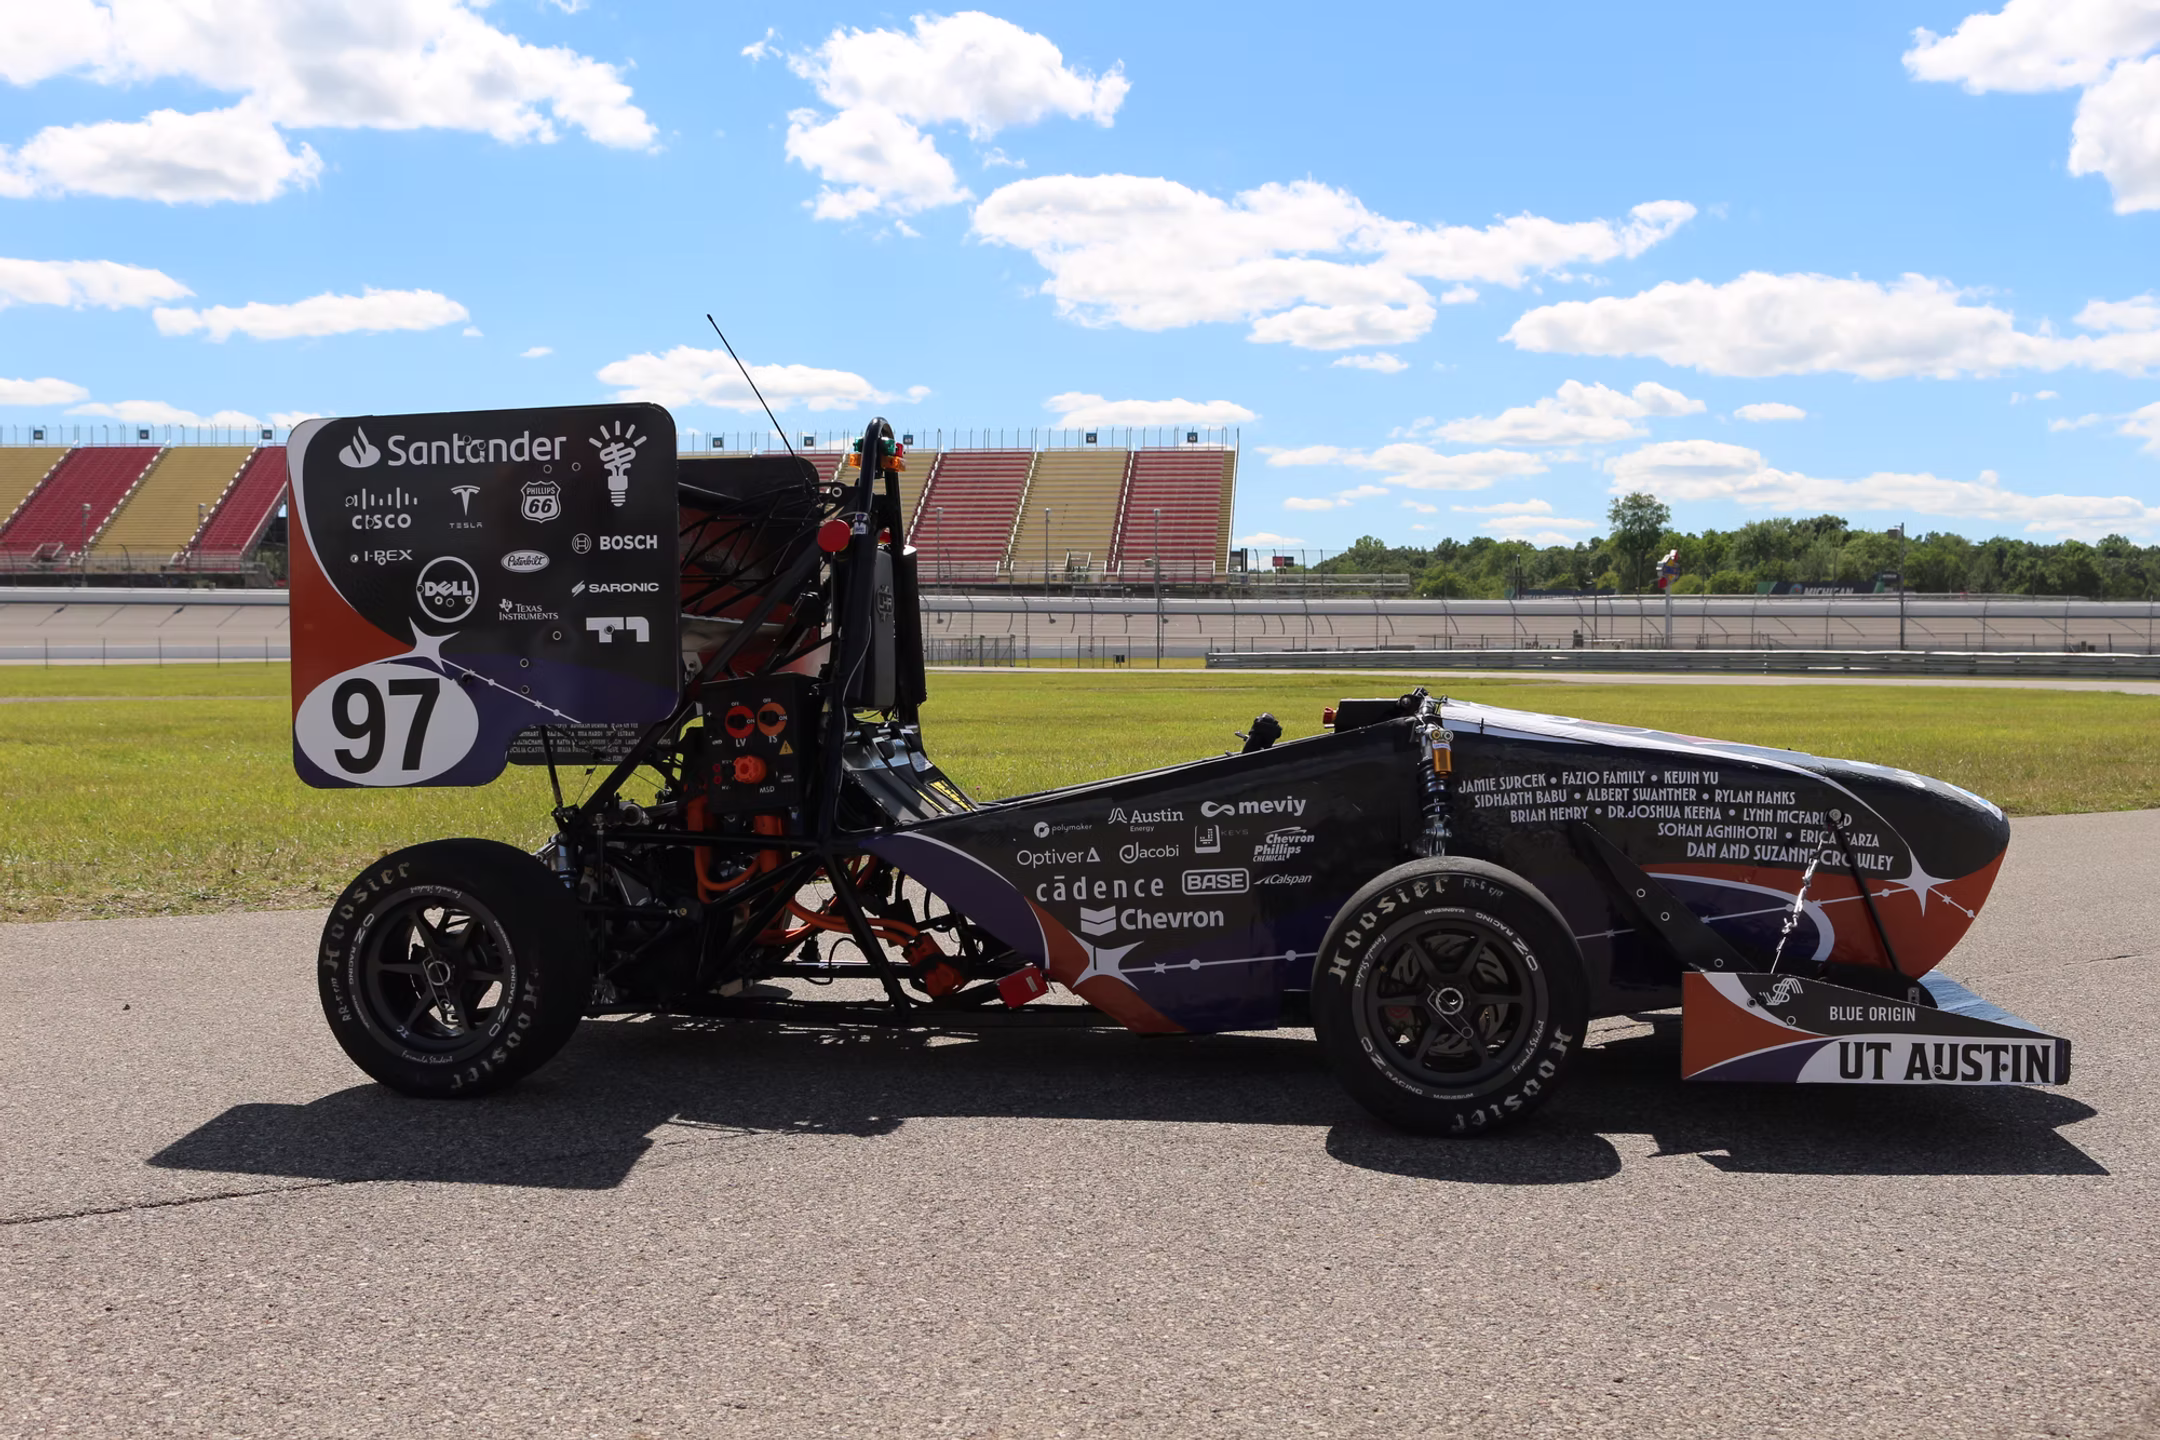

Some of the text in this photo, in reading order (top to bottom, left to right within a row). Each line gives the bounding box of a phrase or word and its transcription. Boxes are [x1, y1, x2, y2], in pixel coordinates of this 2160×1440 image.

[388, 430, 566, 468] Santander
[526, 486, 556, 495] PHILLIPS
[529, 498, 553, 514] 66
[600, 534, 658, 550] BOSCH
[508, 556, 546, 566] Peterbilt
[424, 580, 473, 597] DELL
[588, 582, 660, 592] SARONIC
[332, 677, 440, 774] 97
[736, 738, 746, 747] LV
[1458, 778, 1496, 793] JAMIE
[1562, 772, 1600, 784] FAZIO
[1604, 770, 1645, 784] FAMILY
[1664, 771, 1699, 784] KEVIN
[1702, 772, 1718, 784] YU
[1238, 796, 1306, 816] meviy
[1475, 788, 1796, 808] SIDHARTH BABU ALBERT SWANTNER RYLAN HANKS
[1128, 807, 1185, 824] Austin
[1510, 808, 1546, 822] BRIAN
[1550, 806, 1588, 820] HENRY
[1684, 806, 1722, 820] KEENA
[1744, 808, 1773, 822] LYNN
[1776, 811, 1852, 826] MCFARLD
[1052, 824, 1092, 834] polymaker
[1128, 824, 1156, 833] Energy
[1221, 828, 1248, 836] KEYS
[1266, 833, 1315, 844] Chevron
[1658, 822, 1702, 837] SOHAN
[1706, 825, 1777, 840] AGNIHOTRI
[1800, 829, 1836, 844] ERICA
[1016, 848, 1084, 868] Optiver
[1120, 842, 1178, 864] Jacobi
[1254, 844, 1301, 858] Phillips
[1687, 842, 1716, 858] DAN
[1720, 844, 1749, 859] AND
[1036, 876, 1164, 902] cādence
[1186, 872, 1246, 890] BASE
[1270, 874, 1312, 886] Calspan
[322, 861, 410, 970] Hoosier
[1120, 908, 1224, 930] Chevron
[1475, 912, 1513, 937] RACING
[1328, 876, 1449, 985] Hoosier
[349, 944, 359, 984] RACING
[1354, 934, 1386, 987] Formula Student
[1830, 1006, 1916, 1022] BLUE ORIGIN
[452, 975, 541, 1089] Hoosier
[401, 1050, 453, 1064] Formula Student
[1512, 1020, 1544, 1074] Formula Student
[1838, 1041, 2052, 1083] UT AUSTIN
[1386, 1070, 1422, 1095] RACING
[1452, 1024, 1572, 1132] Hoosier
